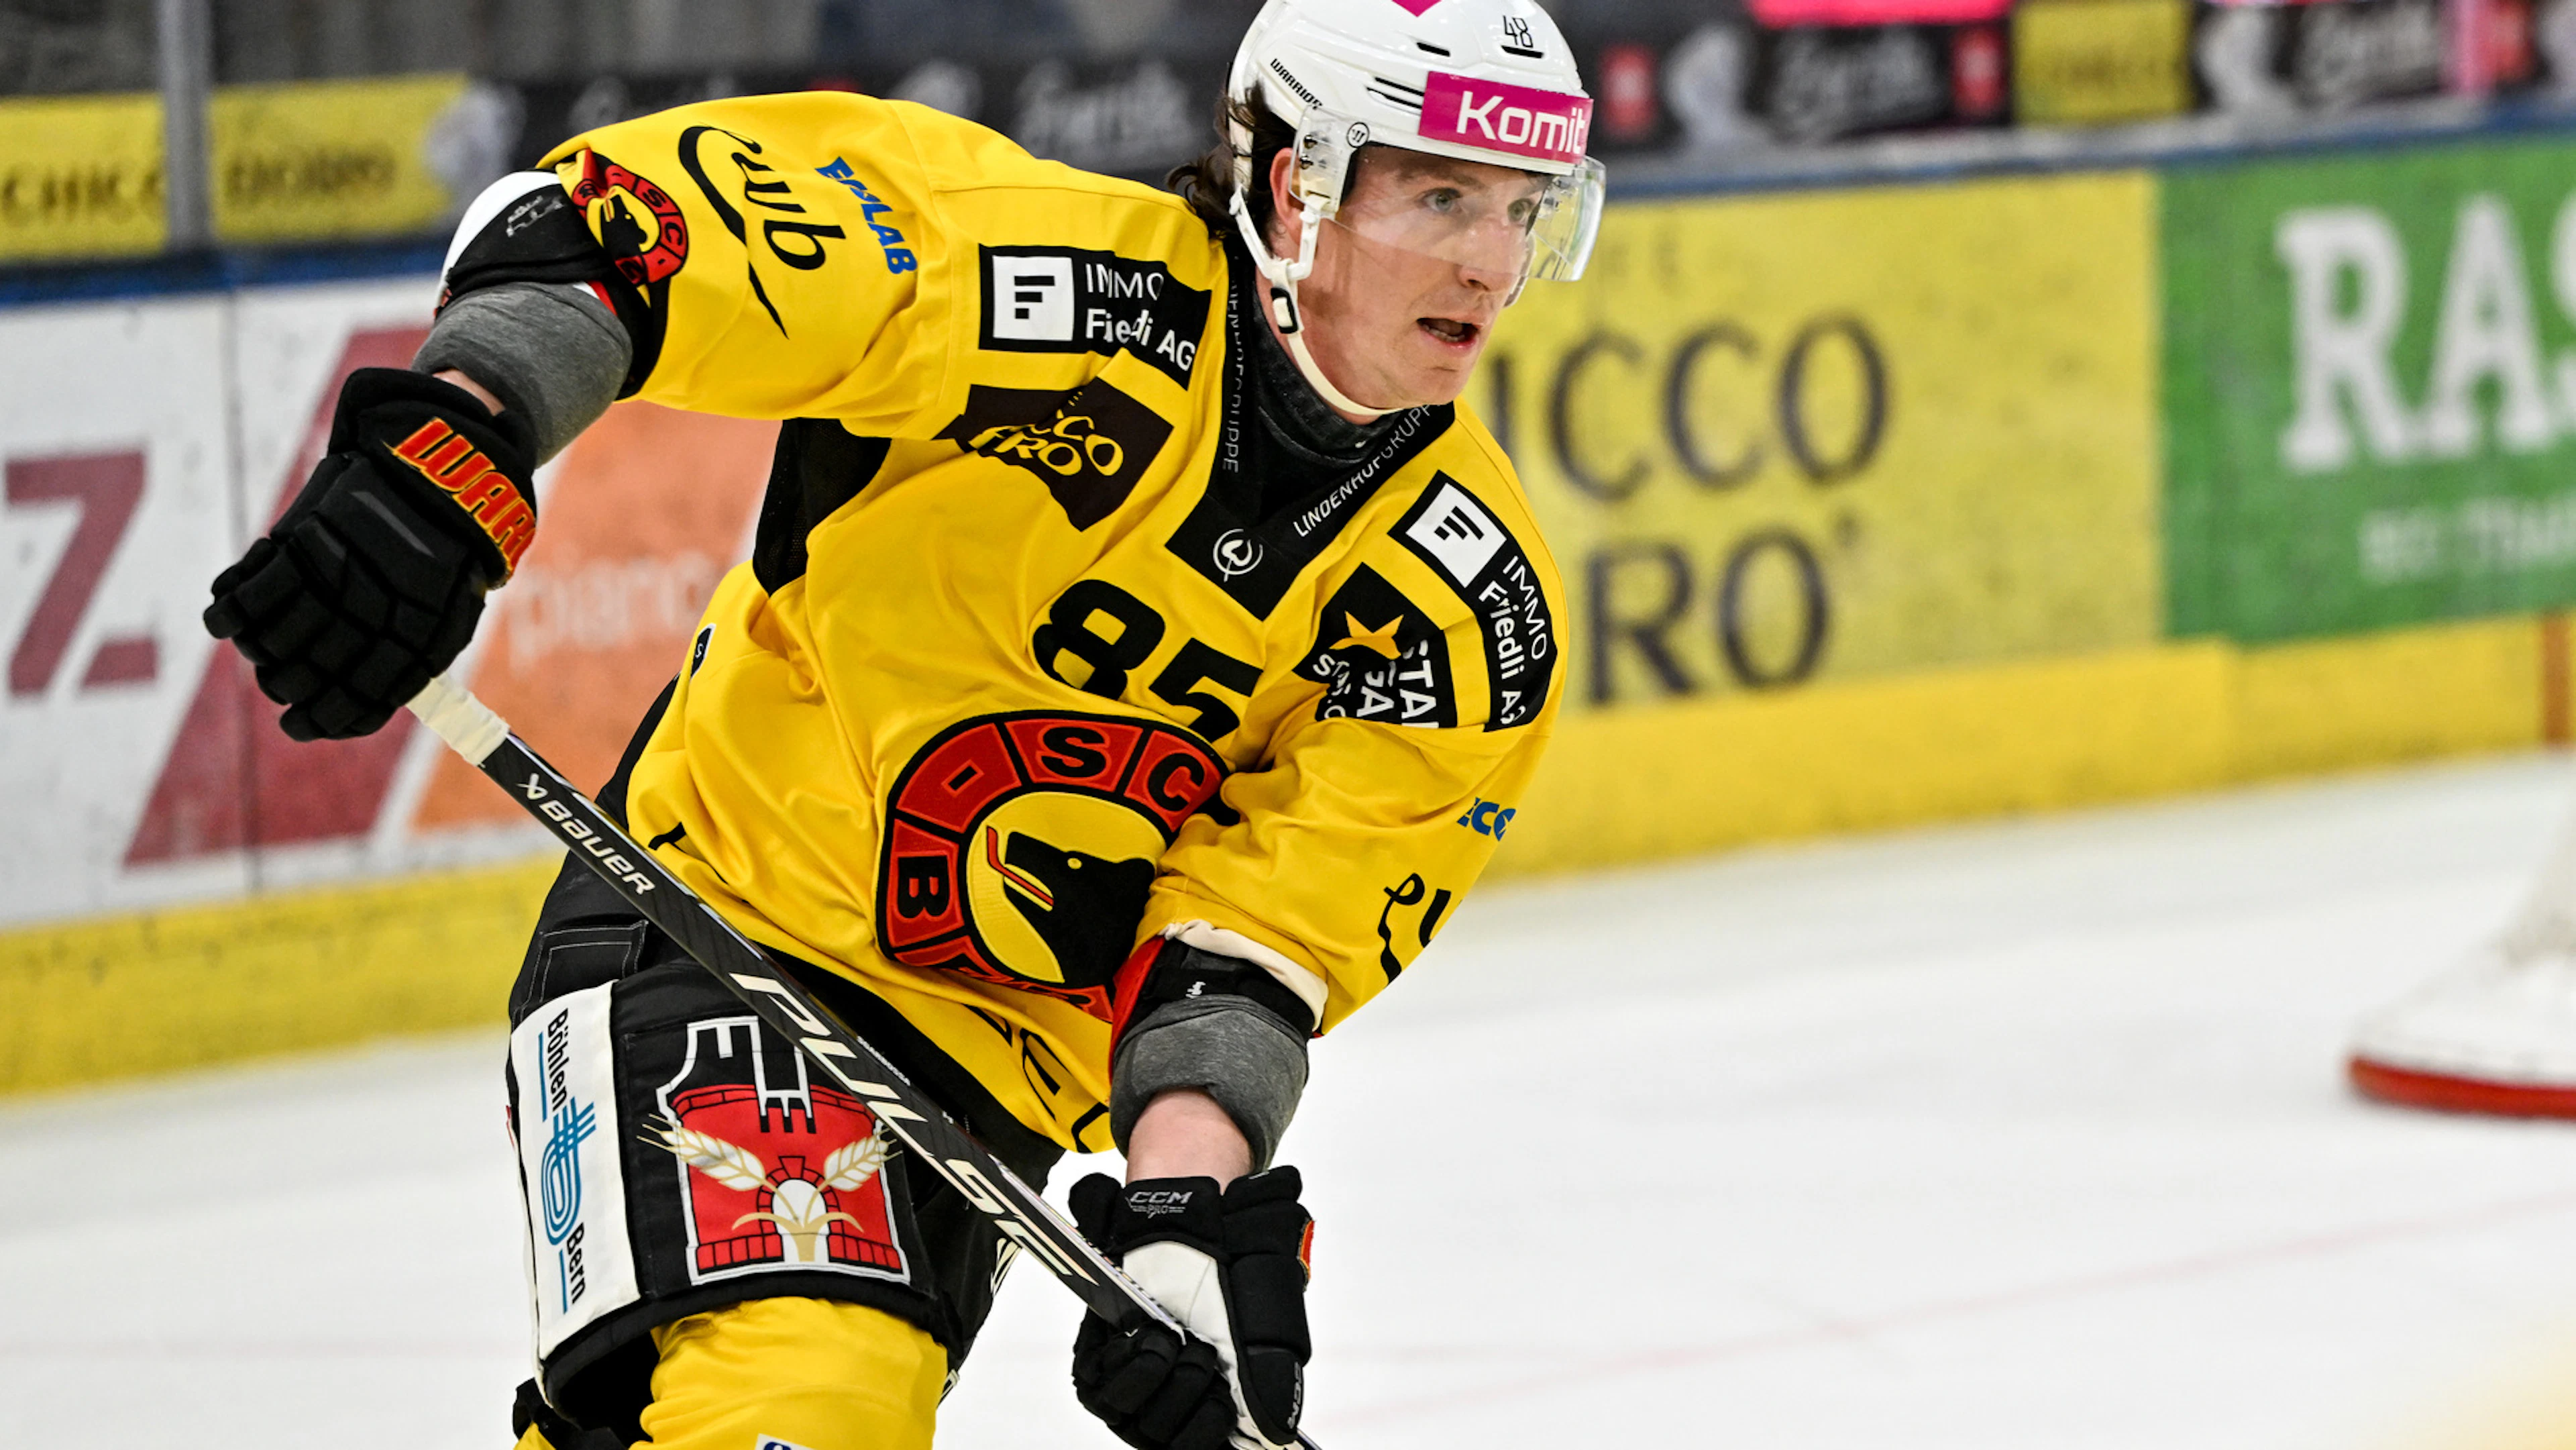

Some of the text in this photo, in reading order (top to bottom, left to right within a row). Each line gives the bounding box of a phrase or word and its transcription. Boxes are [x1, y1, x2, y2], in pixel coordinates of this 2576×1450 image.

[1503, 15, 1534, 48] 48
[1456, 91, 1586, 154] Komit
[1156, 329, 1196, 371] AG
[392, 417, 536, 571] WAR
[1503, 555, 1548, 661] IMMO
[1032, 579, 1264, 743] 85
[547, 1008, 570, 1111] Böhlen
[729, 972, 1100, 1286] PULSE
[1130, 1191, 1193, 1204] CCM
[566, 1223, 586, 1304] Bern
